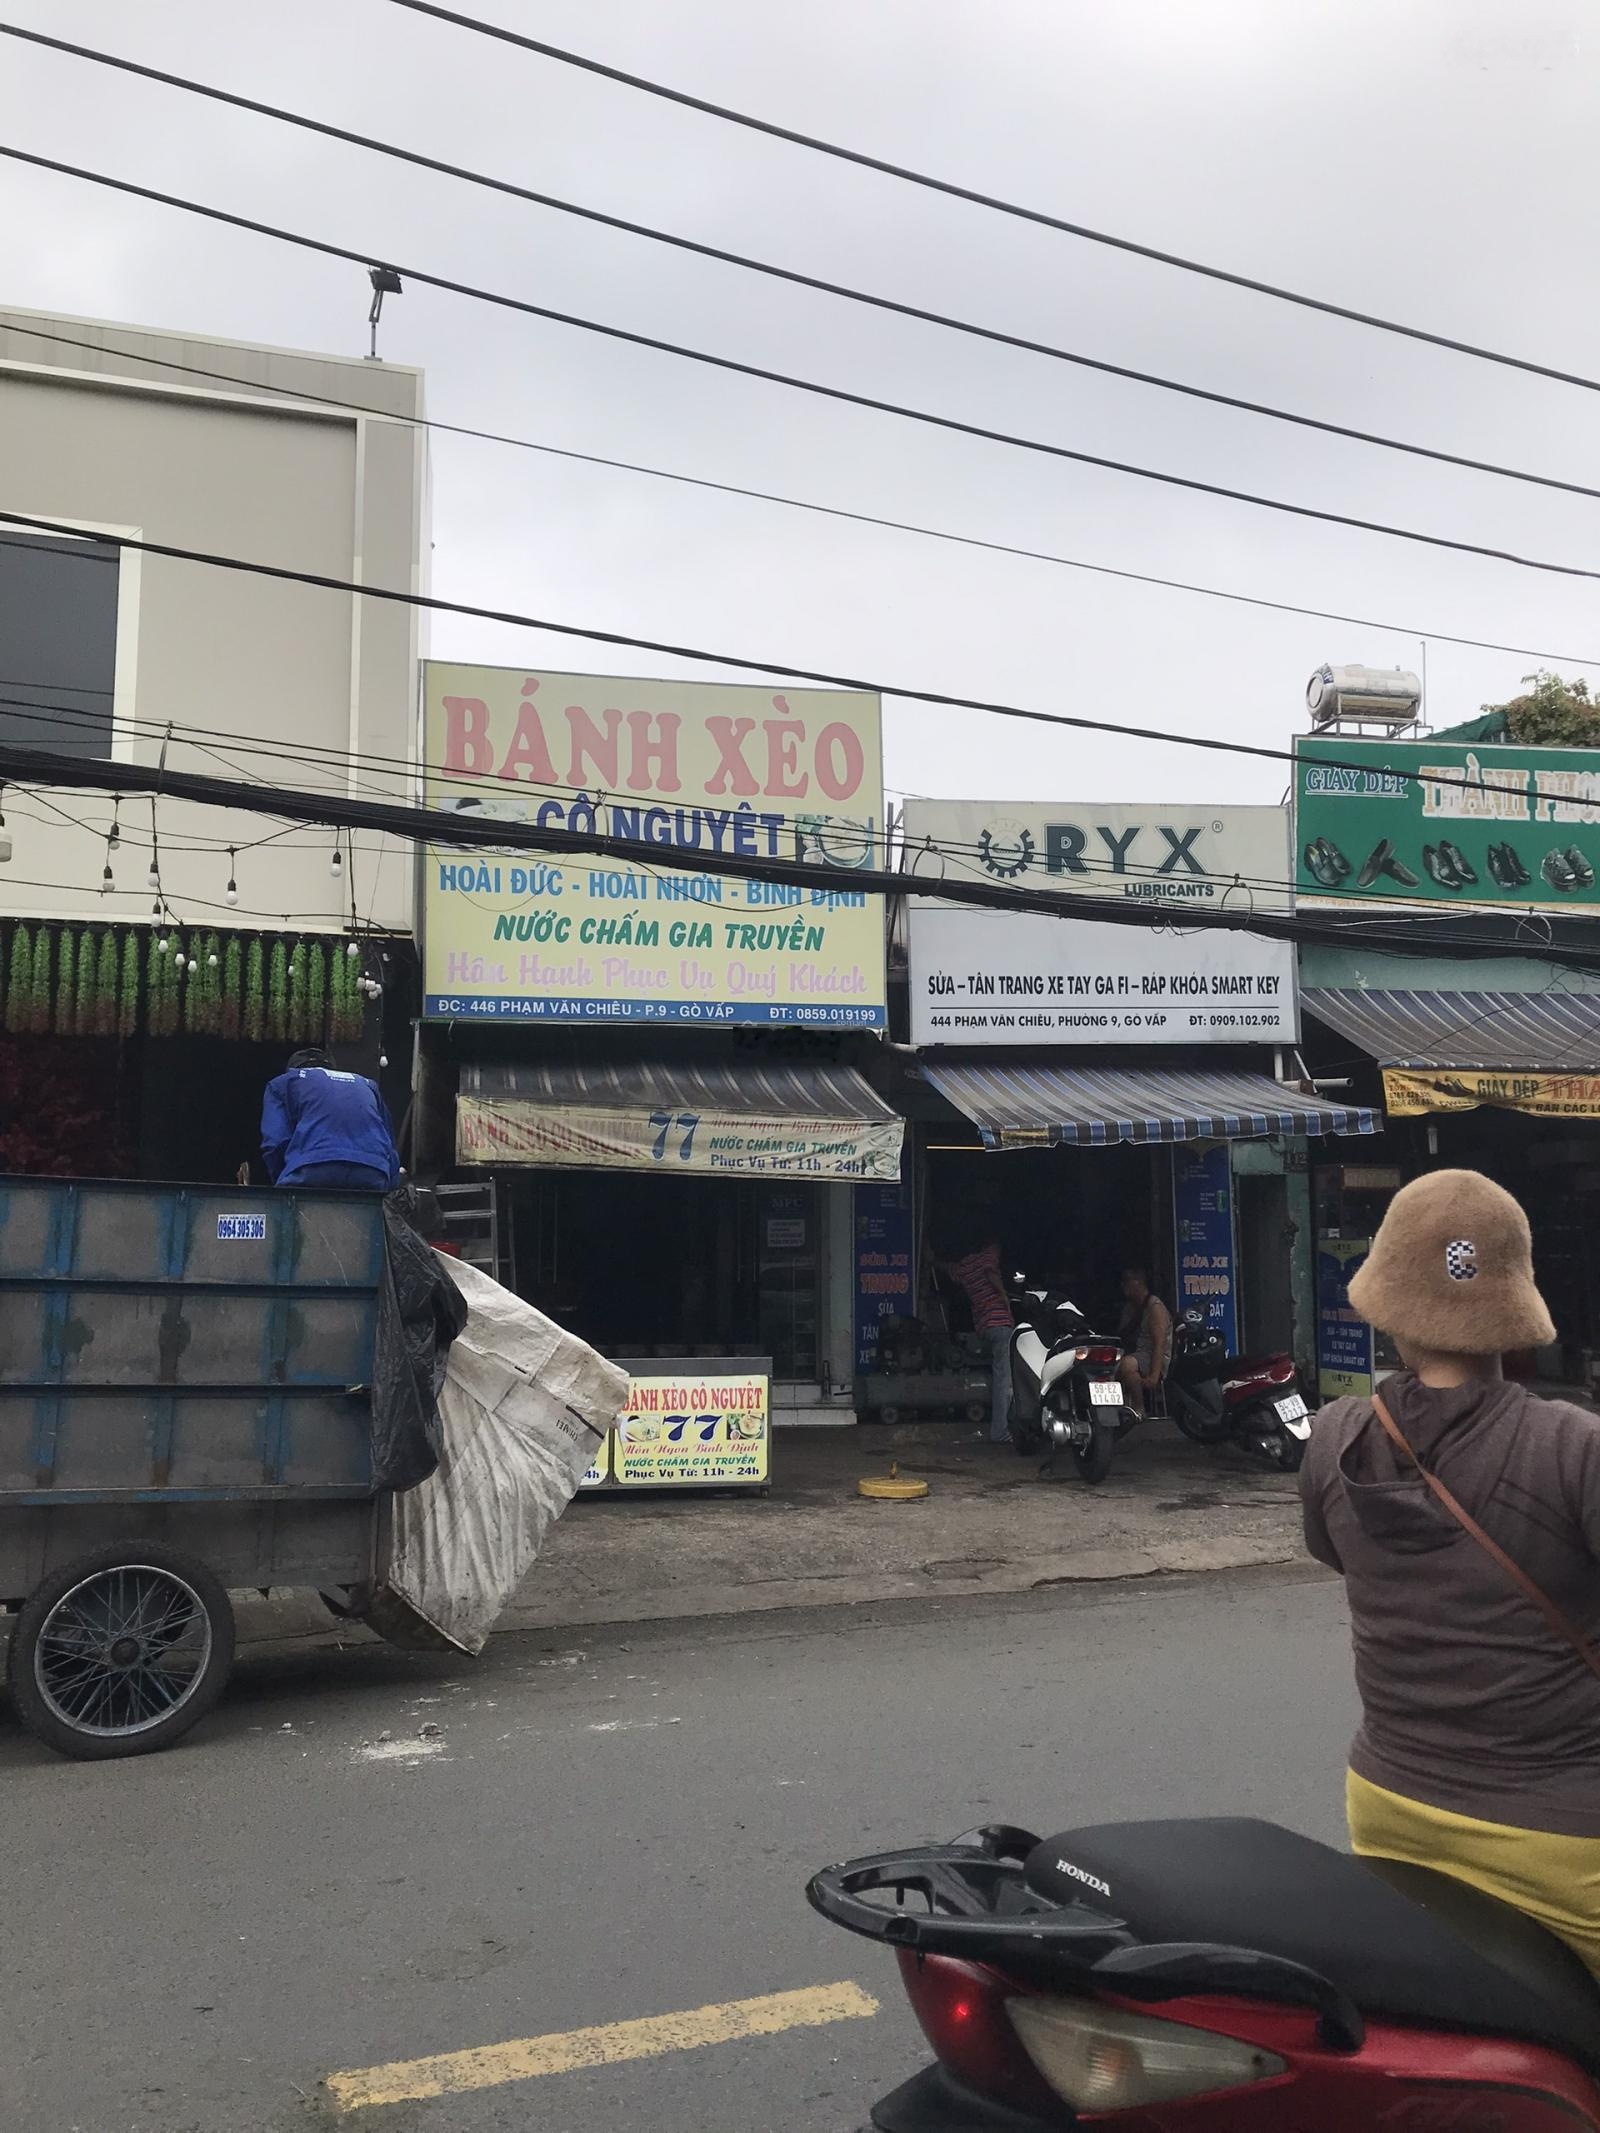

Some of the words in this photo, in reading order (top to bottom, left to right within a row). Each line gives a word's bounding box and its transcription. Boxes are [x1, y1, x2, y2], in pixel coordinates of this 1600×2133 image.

[442, 678, 682, 792] BÁNH
[704, 695, 864, 800] XÈO
[440, 860, 501, 893] HOÀI
[510, 863, 563, 896] ĐỨC
[589, 867, 647, 900] HOÀI
[657, 874, 722, 903] NHƠN
[1125, 883, 1214, 897] LUBRICANTS
[493, 910, 572, 944] NƯỚC
[580, 910, 660, 947] CHẤM
[669, 922, 713, 948] GIA
[724, 914, 825, 951] TRUYỀN
[519, 954, 593, 993] Hạnh
[601, 956, 670, 995] Phục
[679, 960, 716, 997] Vụ
[726, 961, 776, 998] Quý
[789, 962, 868, 995] Khách
[928, 970, 956, 995] SỬA
[968, 971, 995, 995] TÂN
[998, 975, 1044, 995] TRANG
[1048, 975, 1064, 995] XE
[1067, 975, 1091, 995] TAY
[1094, 975, 1115, 995] GA
[1118, 975, 1129, 995] FI
[1142, 971, 1166, 995] RÁP
[1170, 971, 1208, 995] KHÓA
[1211, 975, 1253, 995] SMART
[1257, 975, 1280, 995] KEY
[438, 1000, 466, 1012] ĐC:
[470, 1001, 496, 1013] 446
[500, 1001, 545, 1016] PHẠM
[550, 999, 582, 1015] VĂN
[585, 1000, 632, 1015] CHIÊU
[645, 1004, 667, 1017] P.9
[679, 1001, 702, 1018] GÒ
[705, 1002, 735, 1018] VẤP
[769, 1007, 793, 1019] ĐT:
[796, 1007, 876, 1021] 0859.019199
[931, 1016, 951, 1027] 444
[955, 1016, 988, 1029] PHẠM
[1058, 1013, 1108, 1027] PHƯỜNG
[1111, 1016, 1121, 1028] 9,
[1124, 1013, 1142, 1026] GÒ
[1145, 1012, 1167, 1026] VẤP
[1189, 1015, 1207, 1026] ĐT:
[1210, 1015, 1280, 1026] 0909.102.902
[647, 1111, 702, 1161] 77
[709, 1136, 744, 1150] NƯỚC
[786, 1142, 806, 1153] GIA
[710, 1154, 744, 1170] Phục
[749, 1156, 766, 1171] Vụ
[797, 1158, 821, 1171] 11h
[835, 1159, 860, 1173] 24h
[661, 1382, 687, 1411] XÈO
[691, 1381, 707, 1410] CÔ
[692, 1457, 710, 1466] GIA
[584, 1470, 600, 1479] 4h
[625, 1469, 655, 1479] Phục
[659, 1469, 674, 1479] Vụ
[703, 1467, 725, 1476] 11h
[737, 1466, 760, 1475] 24h
[1056, 1859, 1111, 1896] HONDA
